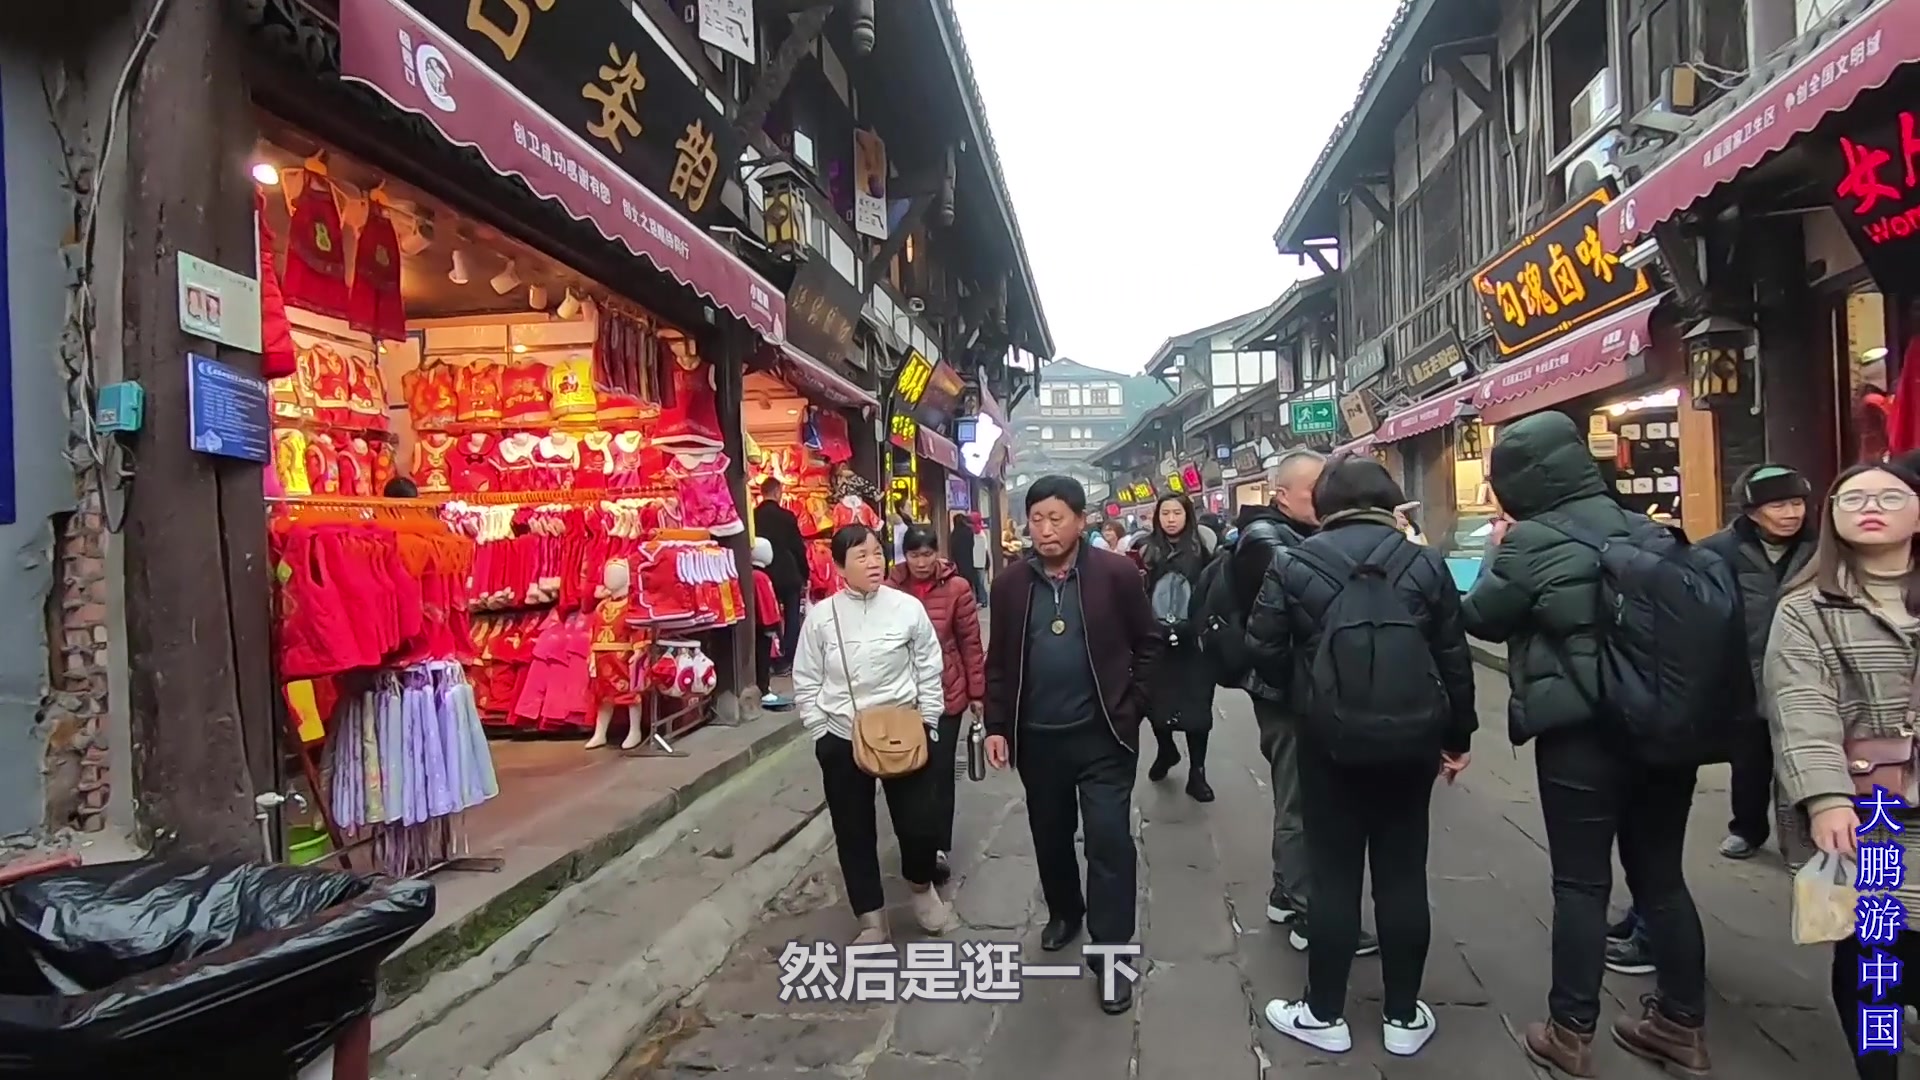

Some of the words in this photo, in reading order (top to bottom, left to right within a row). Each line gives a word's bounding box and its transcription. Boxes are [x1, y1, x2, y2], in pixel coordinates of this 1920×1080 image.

[512, 120, 612, 205] 创卫成功感谢有您
[1495, 224, 1619, 327] 勾魂卤味
